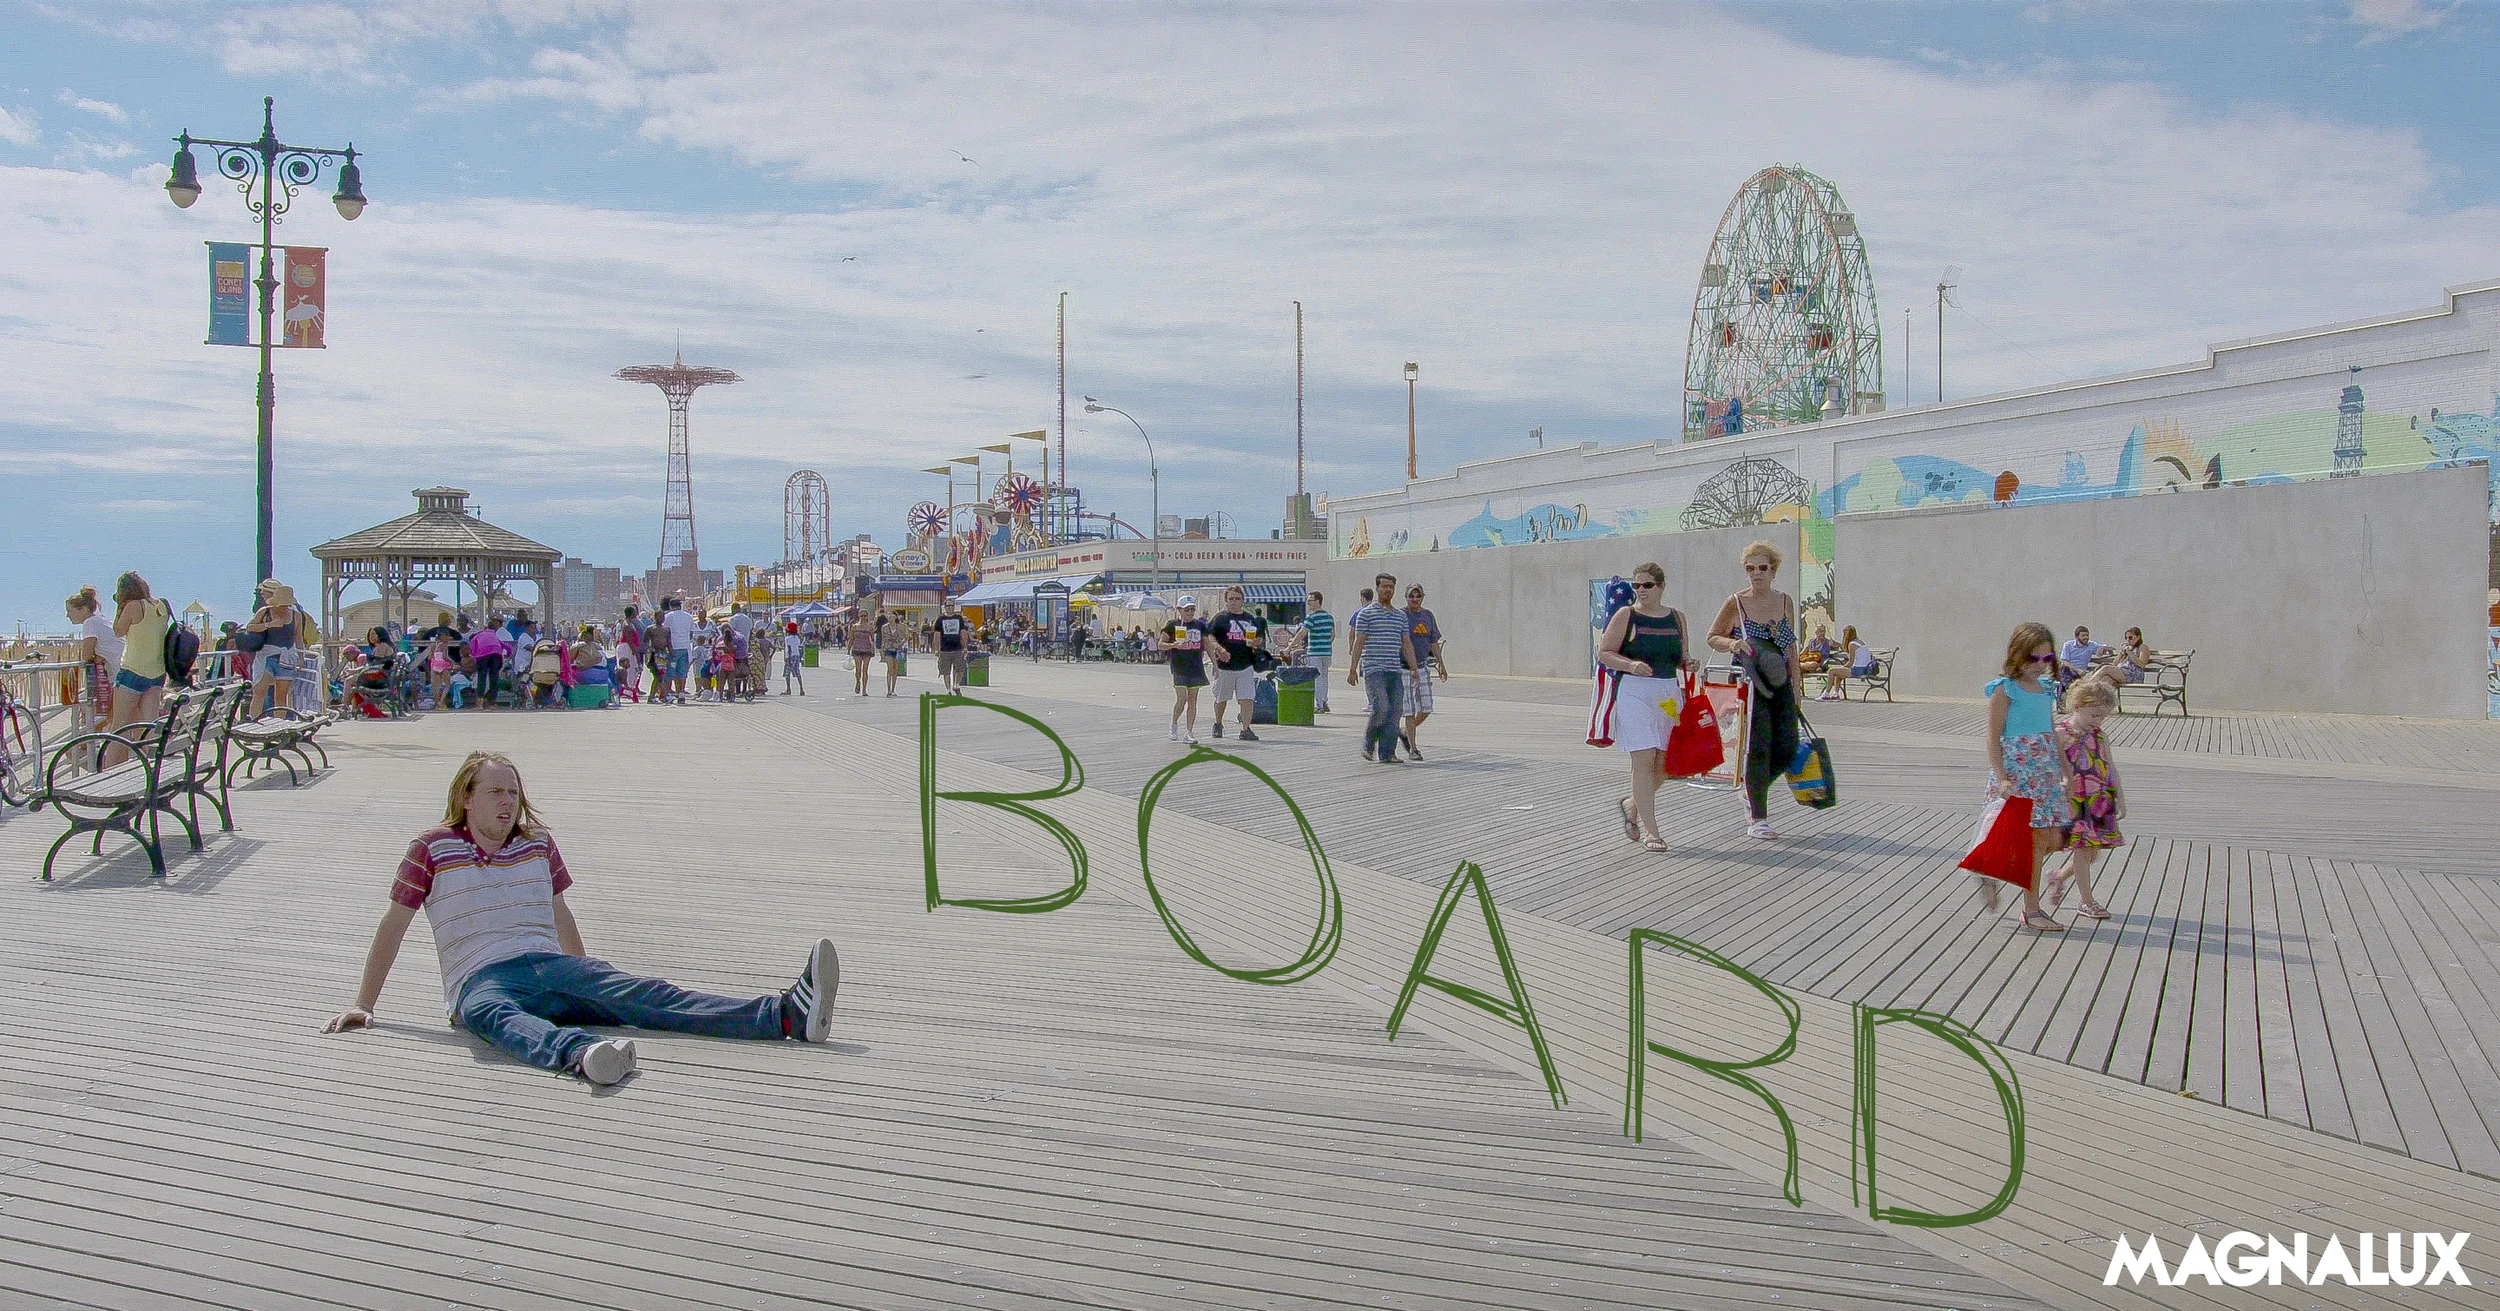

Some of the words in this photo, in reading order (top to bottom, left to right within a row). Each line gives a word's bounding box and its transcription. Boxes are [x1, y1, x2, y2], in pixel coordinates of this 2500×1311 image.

[218, 286, 242, 294] ISLAND
[1174, 551, 1193, 560] COLD
[1197, 551, 1216, 560] BEER
[1227, 551, 1246, 560] SODA
[1255, 551, 1283, 560] FRENCH
[1286, 551, 1307, 560] FRIES
